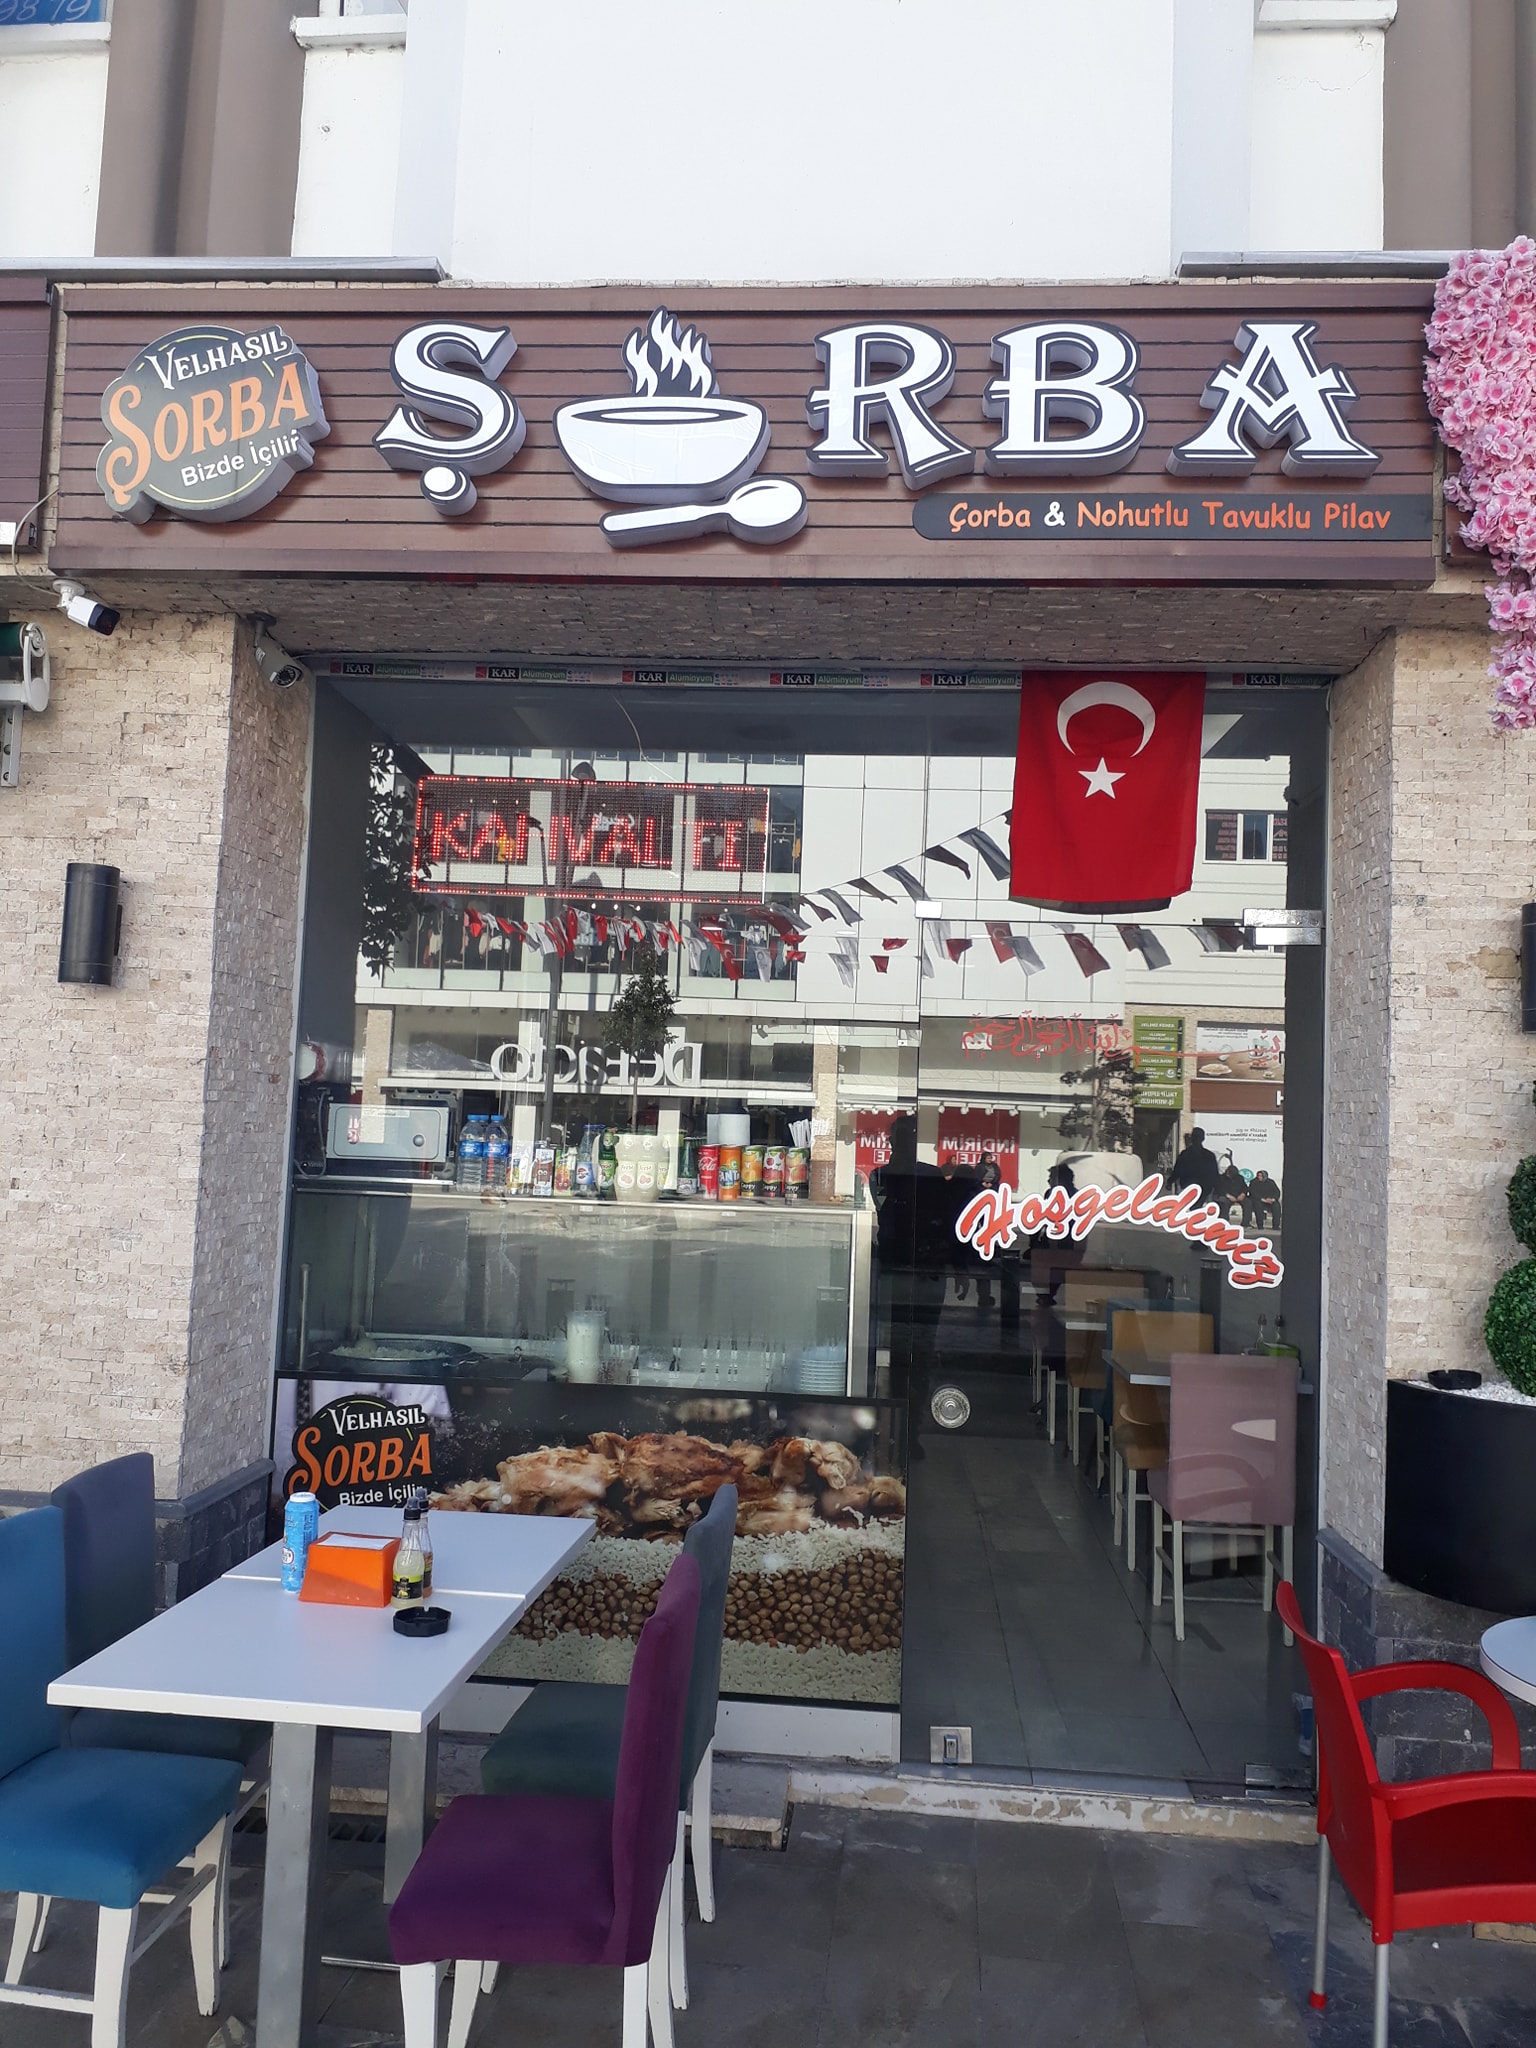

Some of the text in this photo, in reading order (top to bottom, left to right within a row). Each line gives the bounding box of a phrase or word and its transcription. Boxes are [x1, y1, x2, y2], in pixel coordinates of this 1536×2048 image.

[145, 331, 288, 390] VELHASIL
[181, 429, 300, 487] Bizde İçilir
[948, 500, 1391, 532] Çorba & Nohutlu Tavuklu Pilav
[345, 662, 371, 674] KAR
[491, 667, 517, 679] KAR
[638, 672, 663, 683] KAR
[786, 674, 813, 685] KAR
[937, 675, 964, 686] KAR
[1250, 674, 1277, 685] KAR
[432, 812, 743, 868] KAHVALTI
[957, 1174, 1282, 1287] Hoşgeldiniz
[327, 1407, 426, 1436] VELHASIL
[339, 1482, 423, 1507] Bizde İçili
